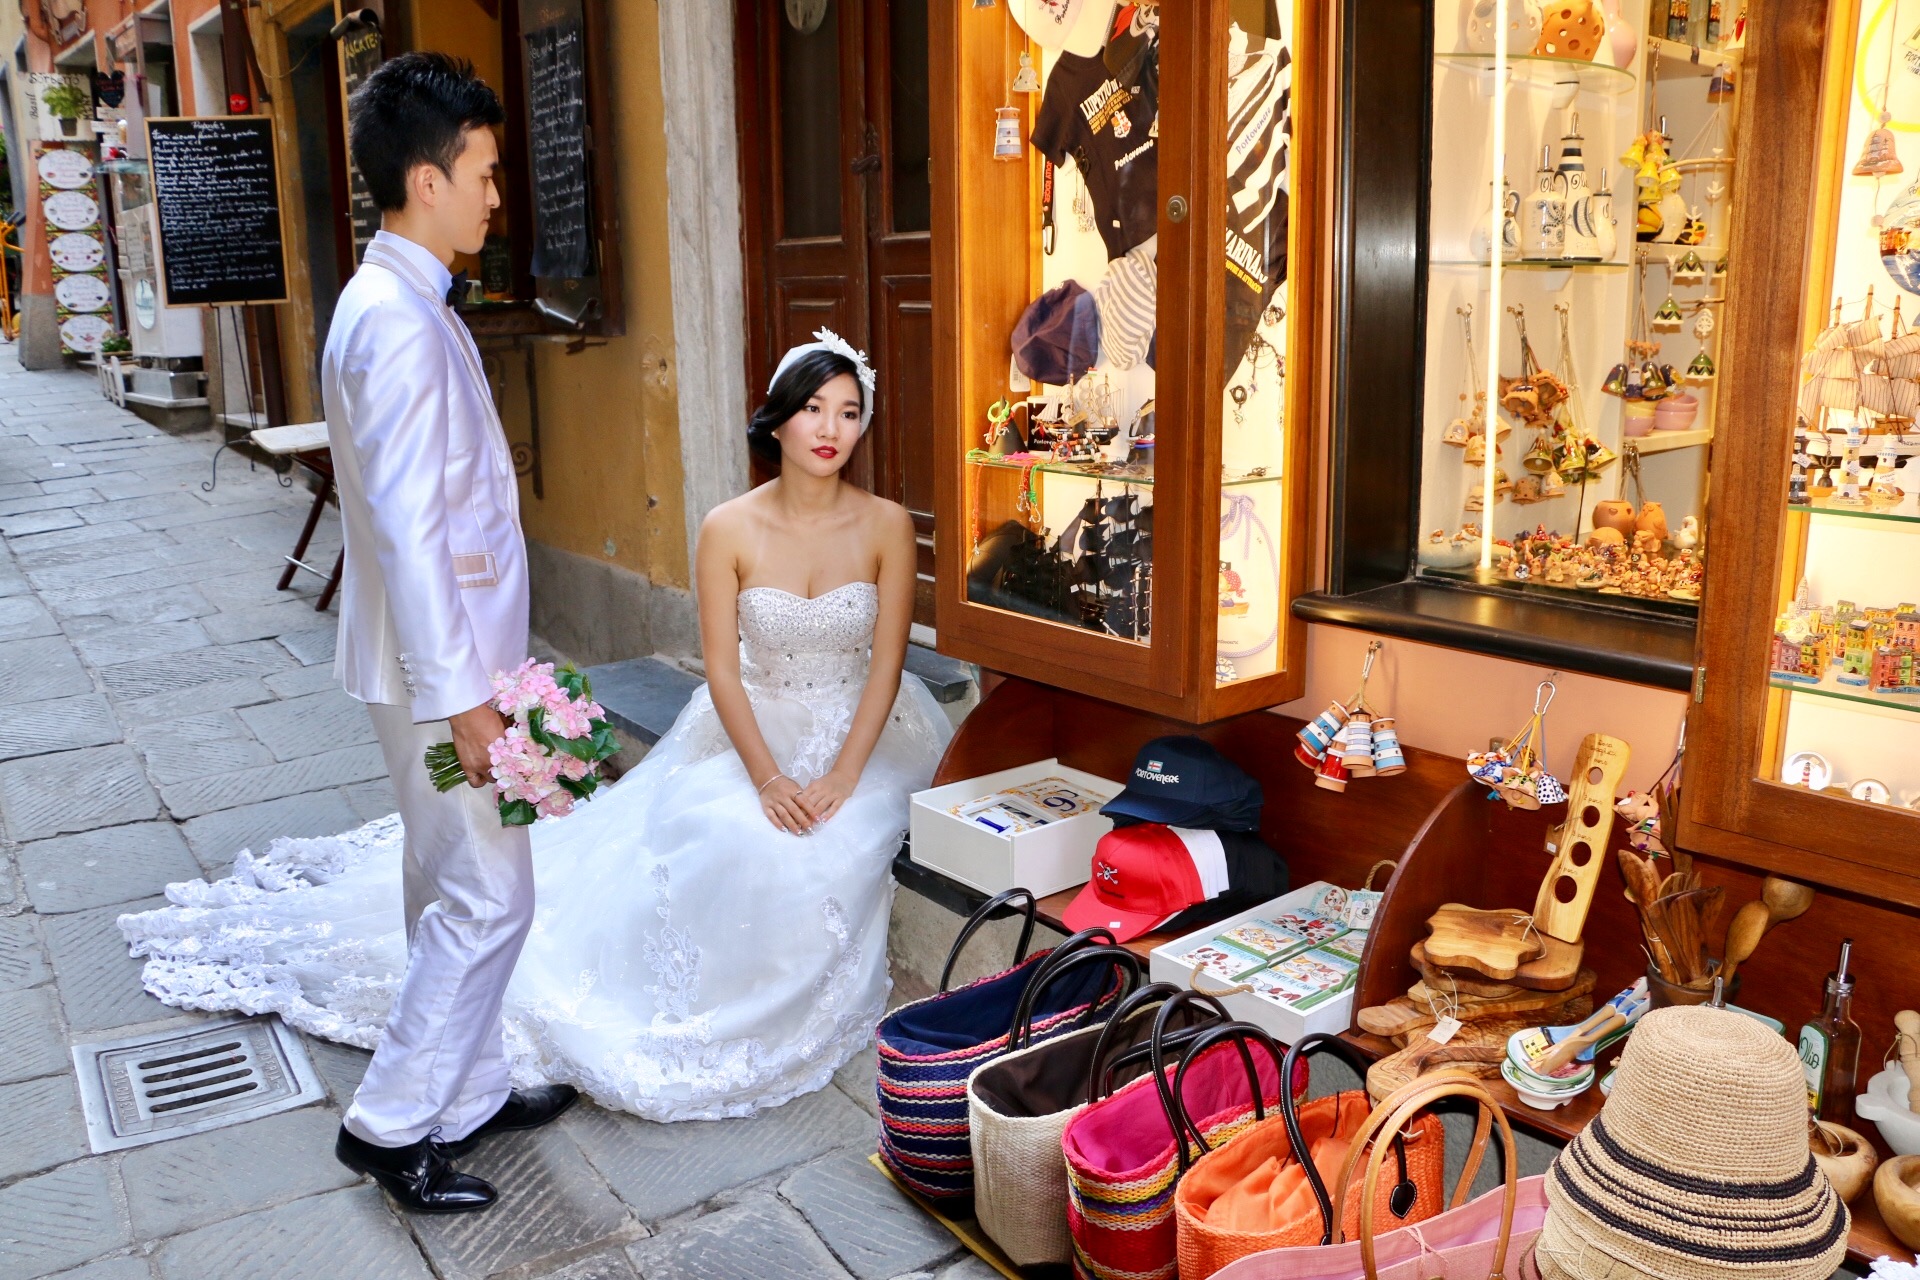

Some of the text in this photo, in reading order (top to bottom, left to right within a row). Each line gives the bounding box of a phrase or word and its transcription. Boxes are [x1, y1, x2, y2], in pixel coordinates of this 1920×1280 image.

[1079, 78, 1112, 121] LUPETTO
[1236, 106, 1271, 155] Portovenere
[1114, 138, 1154, 171] Portovenere
[1043, 160, 1053, 203] JOLLY ROGER
[1134, 767, 1180, 785] PORTOVENERE
[1043, 796, 1075, 812] 9
